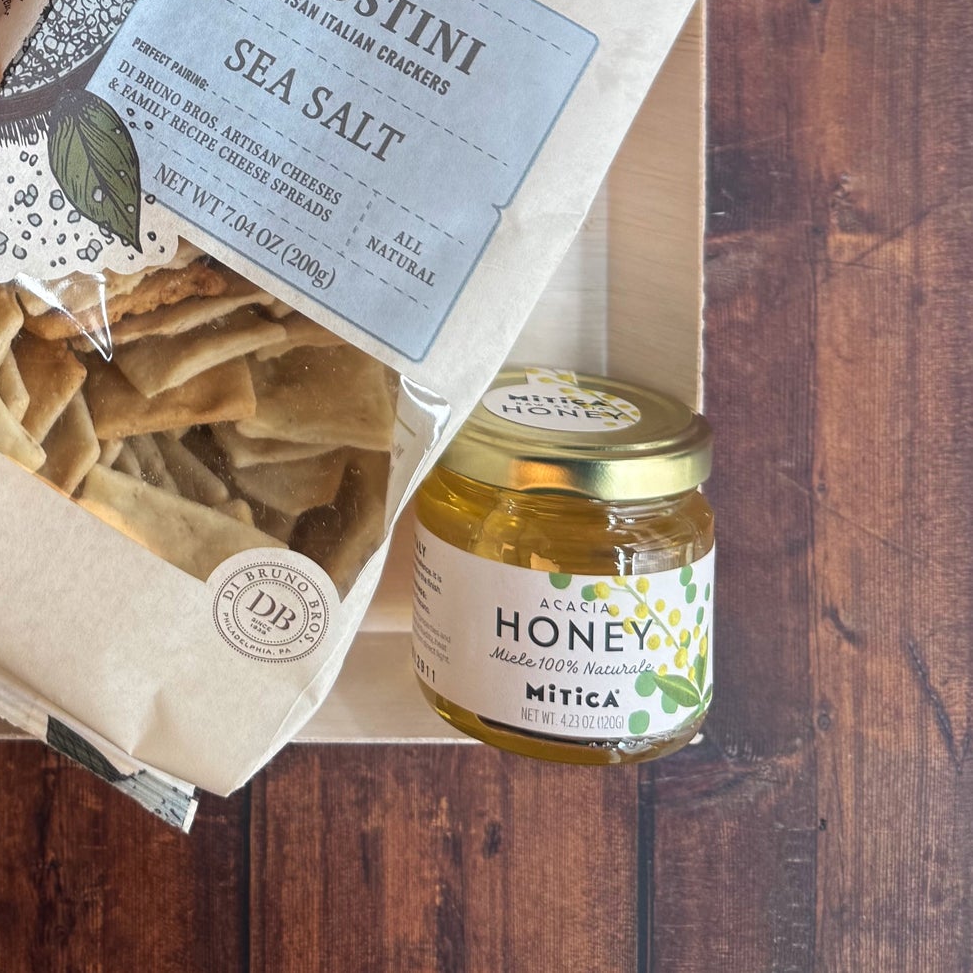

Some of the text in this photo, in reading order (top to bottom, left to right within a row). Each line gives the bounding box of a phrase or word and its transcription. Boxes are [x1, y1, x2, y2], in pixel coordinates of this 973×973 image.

[131, 37, 210, 92] PERFECT PAIRING:
[319, 11, 376, 53] ITALIAN
[376, 45, 451, 96] CRACKERS
[224, 38, 406, 162] SEA SALT
[108, 77, 334, 223] & FAMILY RECIPE CHEESE SPREADS
[116, 59, 343, 206] DI BRUNO BROS. ARTISAN CHEESES
[152, 162, 337, 291] NET WT 7.04 OZ (200g)
[392, 230, 423, 257] ALL
[365, 235, 436, 287] NATURAL
[502, 404, 624, 420] HONEY
[222, 568, 322, 644] DI BRUNO BROS.
[245, 589, 296, 631] DB
[251, 617, 273, 632] SINCE
[496, 606, 653, 652] HONEY
[540, 598, 610, 614] ACACIA
[279, 647, 292, 655] PA
[489, 646, 655, 675] Miele 100% Naturale
[521, 706, 625, 729] NET WT. 4.23 OZ (120G)
